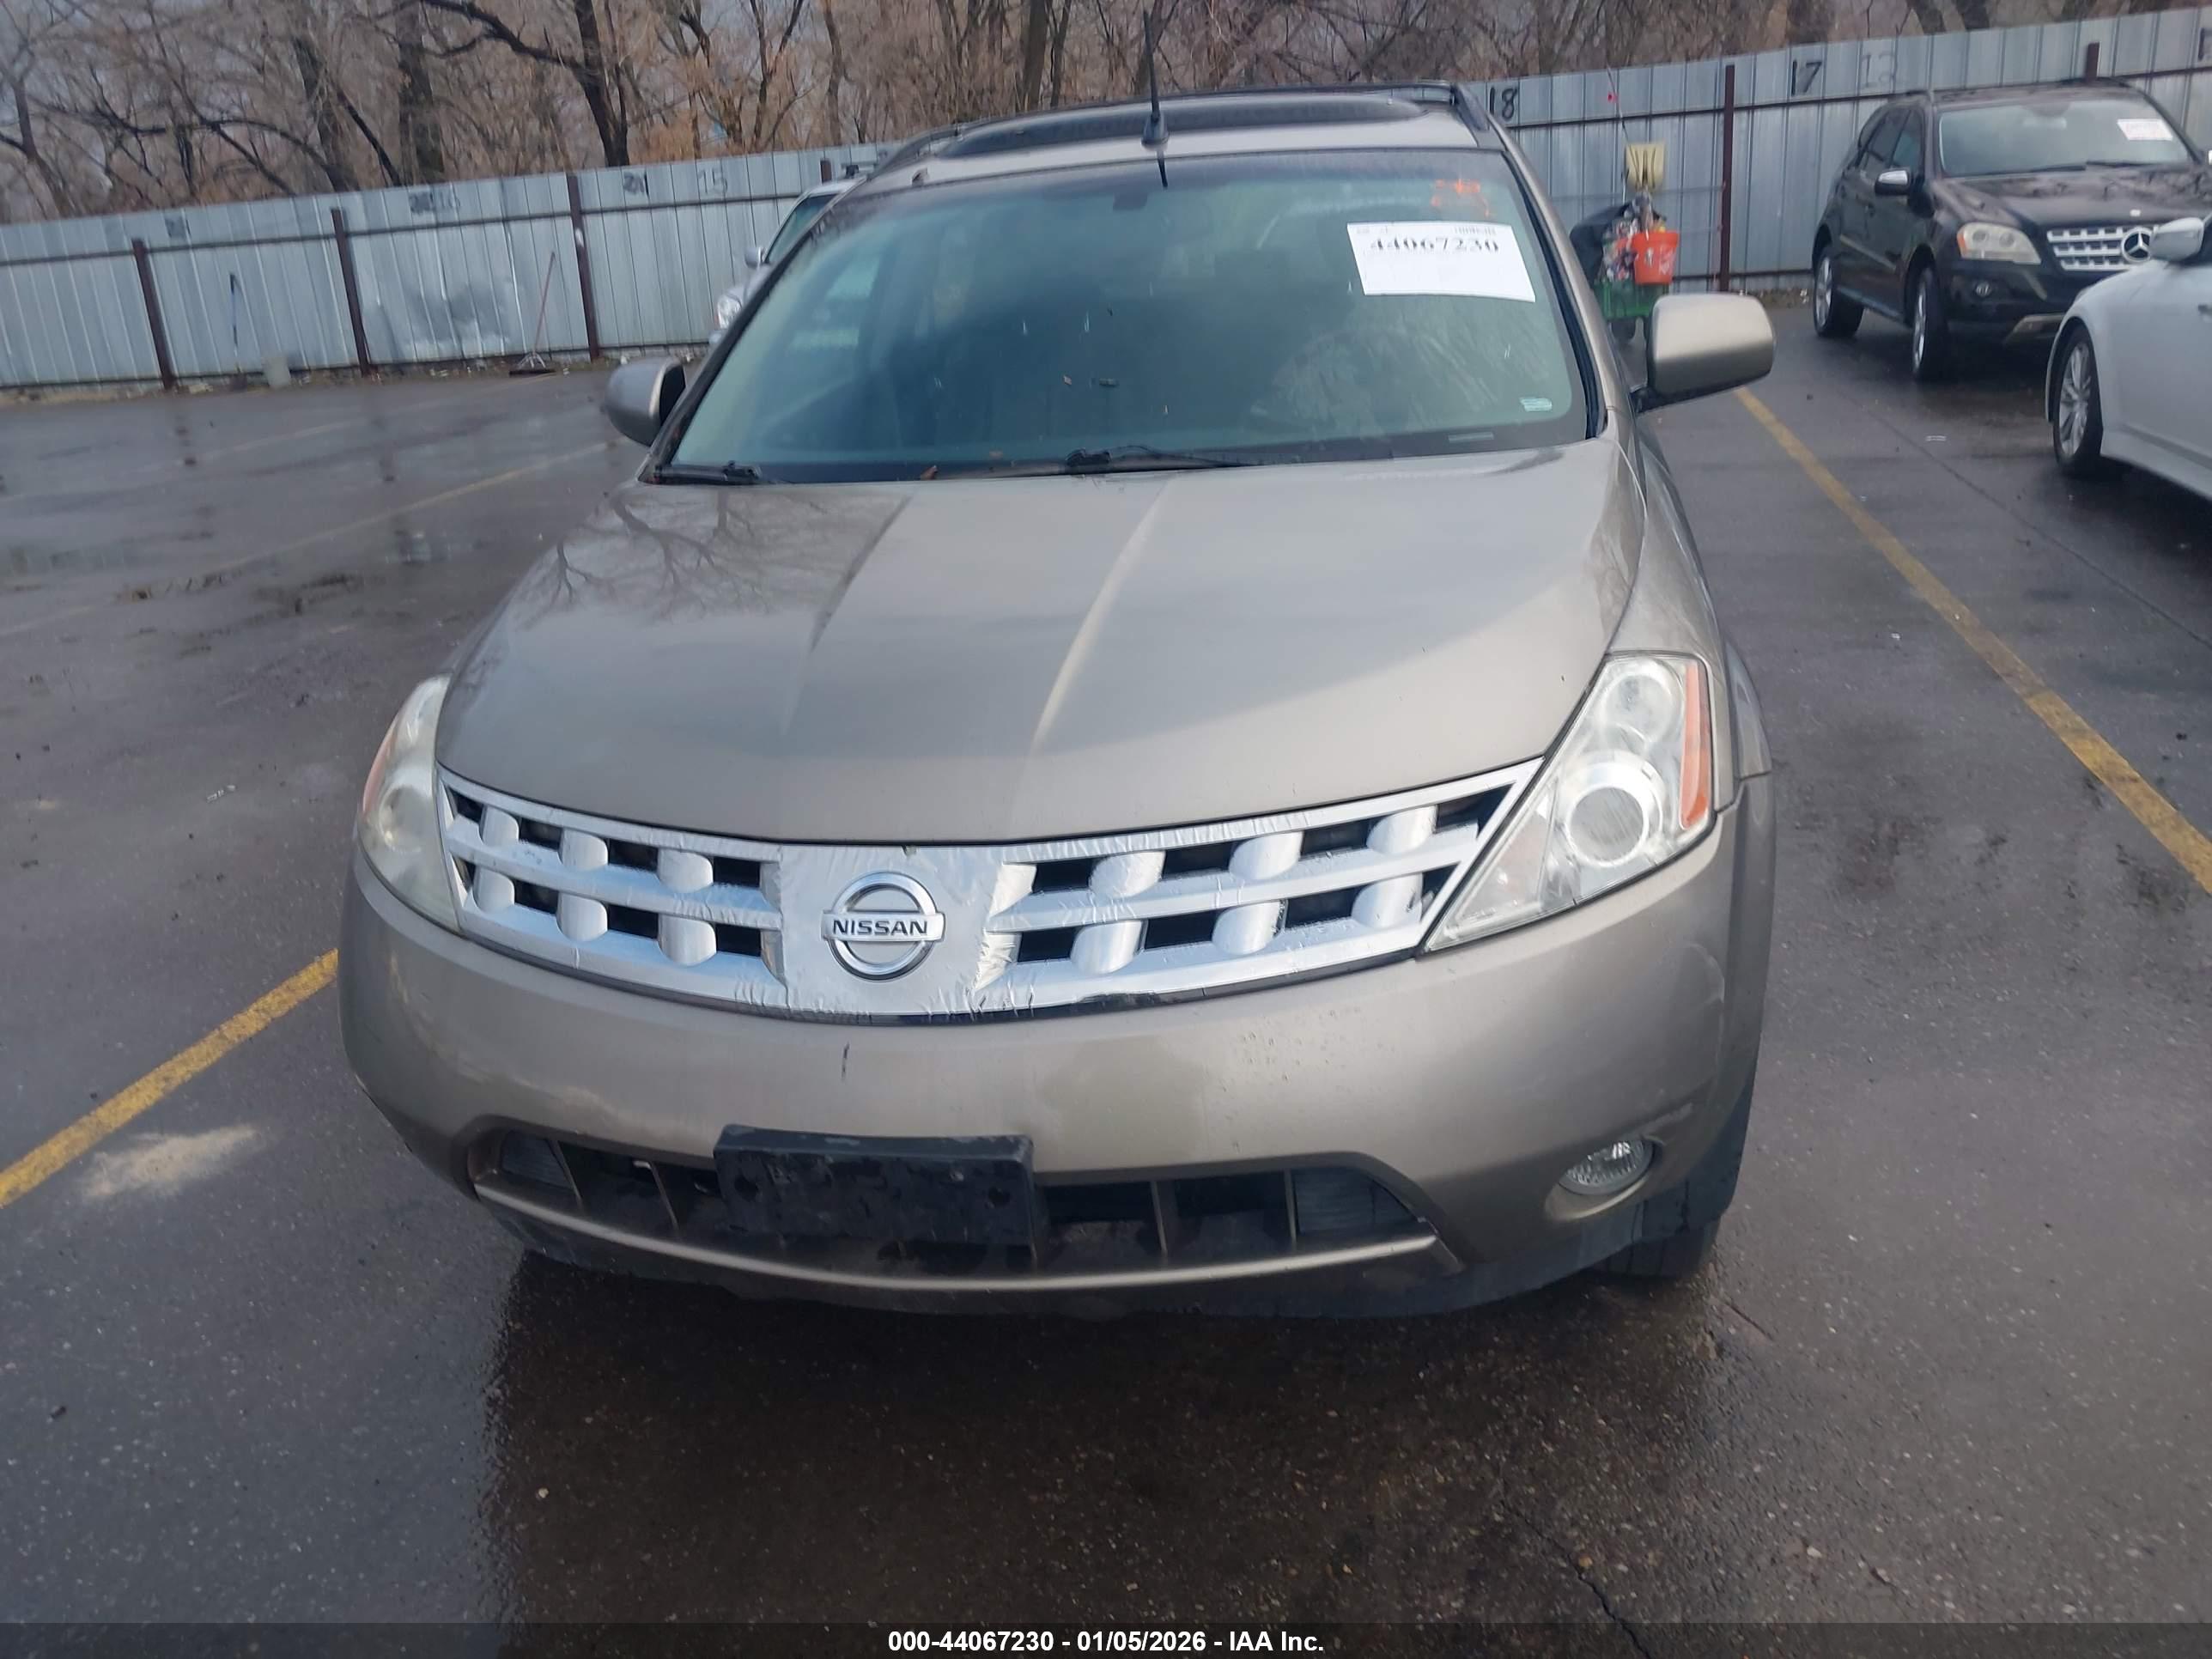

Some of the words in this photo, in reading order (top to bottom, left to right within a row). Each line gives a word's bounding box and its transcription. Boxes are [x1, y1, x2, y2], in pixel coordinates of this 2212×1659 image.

[1791, 59, 1823, 96] 17
[1489, 86, 1518, 122] 18
[1370, 235, 1500, 253] 44067230
[832, 919, 928, 936] NISSAN
